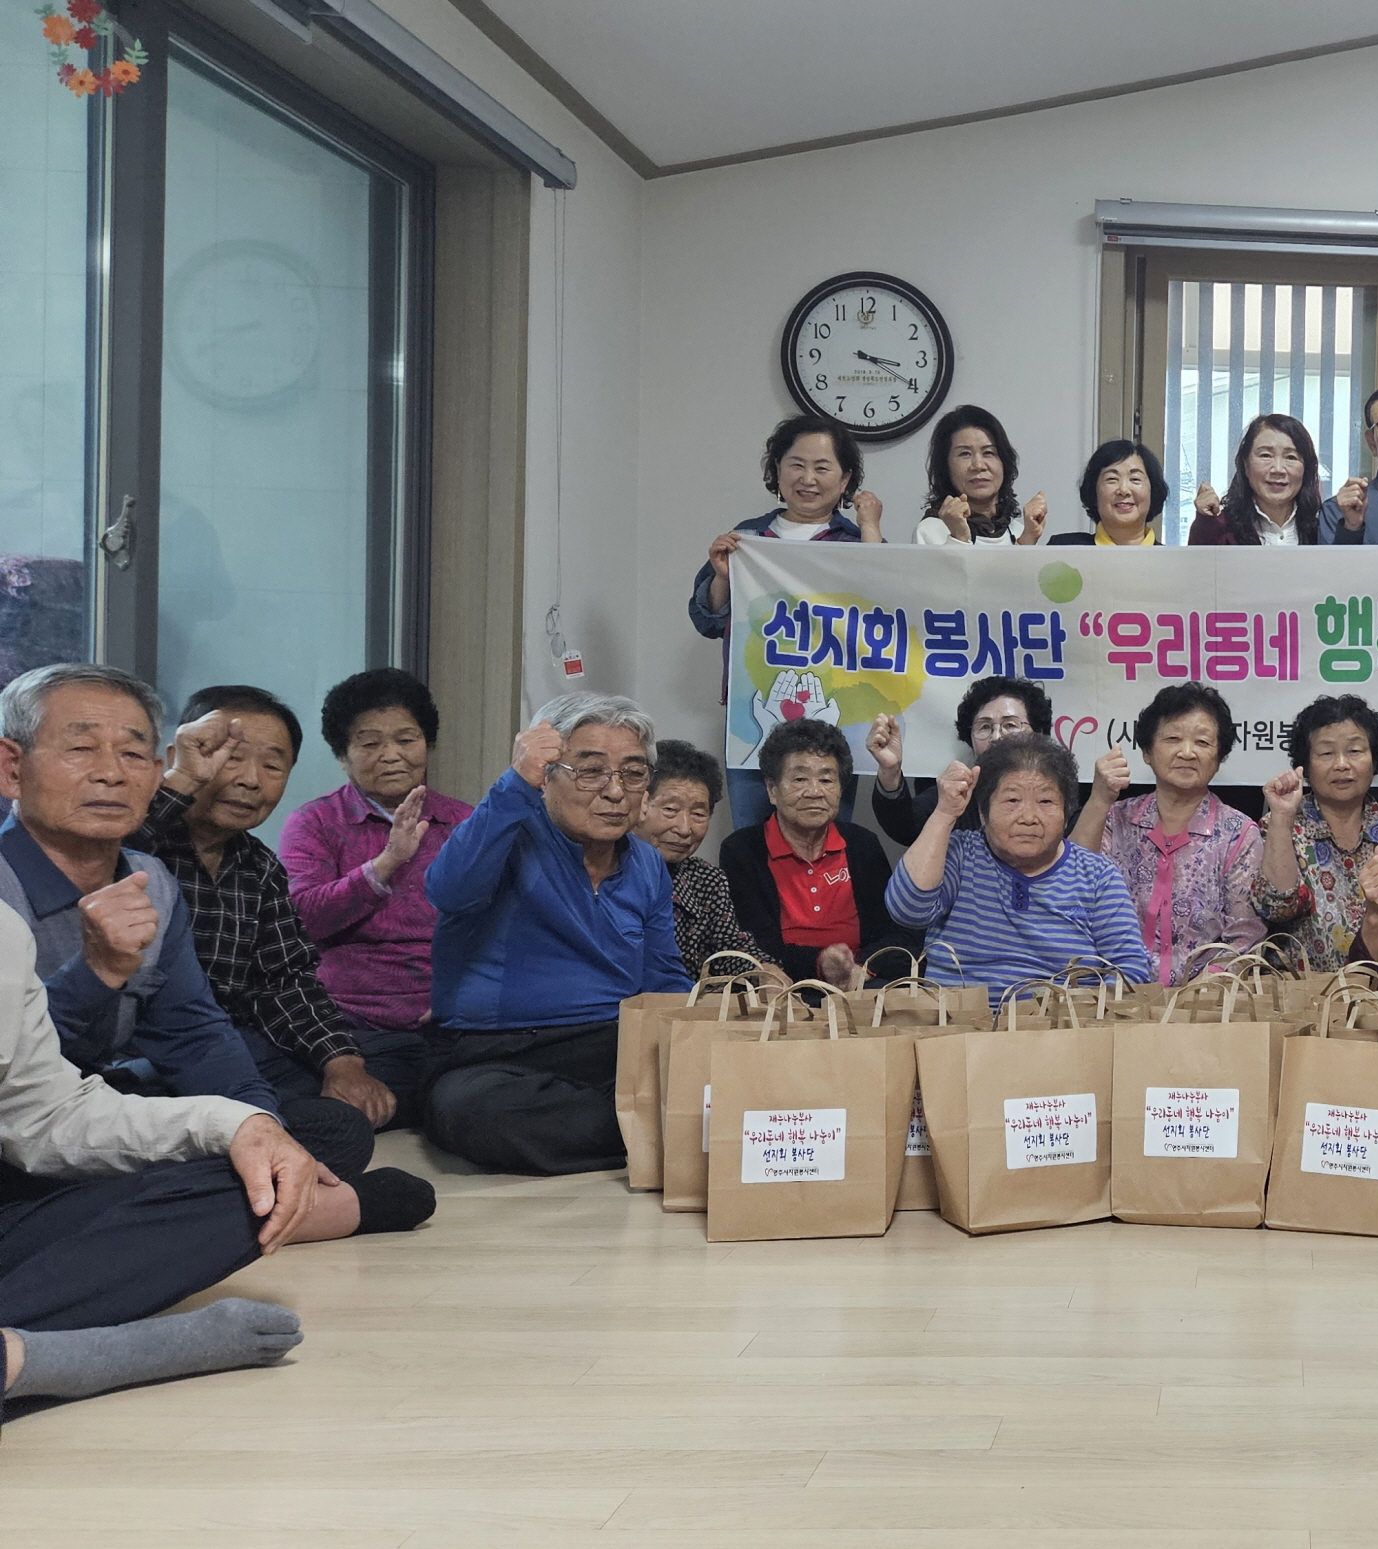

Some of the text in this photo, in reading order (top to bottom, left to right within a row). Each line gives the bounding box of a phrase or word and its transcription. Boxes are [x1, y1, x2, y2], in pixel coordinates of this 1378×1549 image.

[835, 304, 846, 321] 11
[860, 297, 876, 314] 12
[892, 305, 897, 321] 1
[814, 323, 831, 339] 10
[908, 324, 919, 340] 2
[809, 348, 822, 365] 9
[915, 351, 928, 368] 3
[815, 373, 828, 390] 8
[907, 378, 919, 393] 4
[835, 396, 846, 412] 7
[863, 401, 875, 418] 6
[888, 395, 900, 411] 5
[764, 599, 907, 674] 선지회
[923, 609, 1067, 680] 봉사단
[1079, 611, 1299, 681] “우리동네
[1045, 1114, 1062, 1130] 행복
[1186, 1106, 1202, 1122] 행복
[788, 1128, 806, 1145] 행복
[1163, 1124, 1210, 1138] 선지회 봉사단
[1344, 1125, 1360, 1142] 행복
[1024, 1133, 1069, 1149] 선지회 봉사단
[762, 1147, 814, 1162] 선지회 봉사단
[1320, 1142, 1368, 1159] 선지회 봉사단
